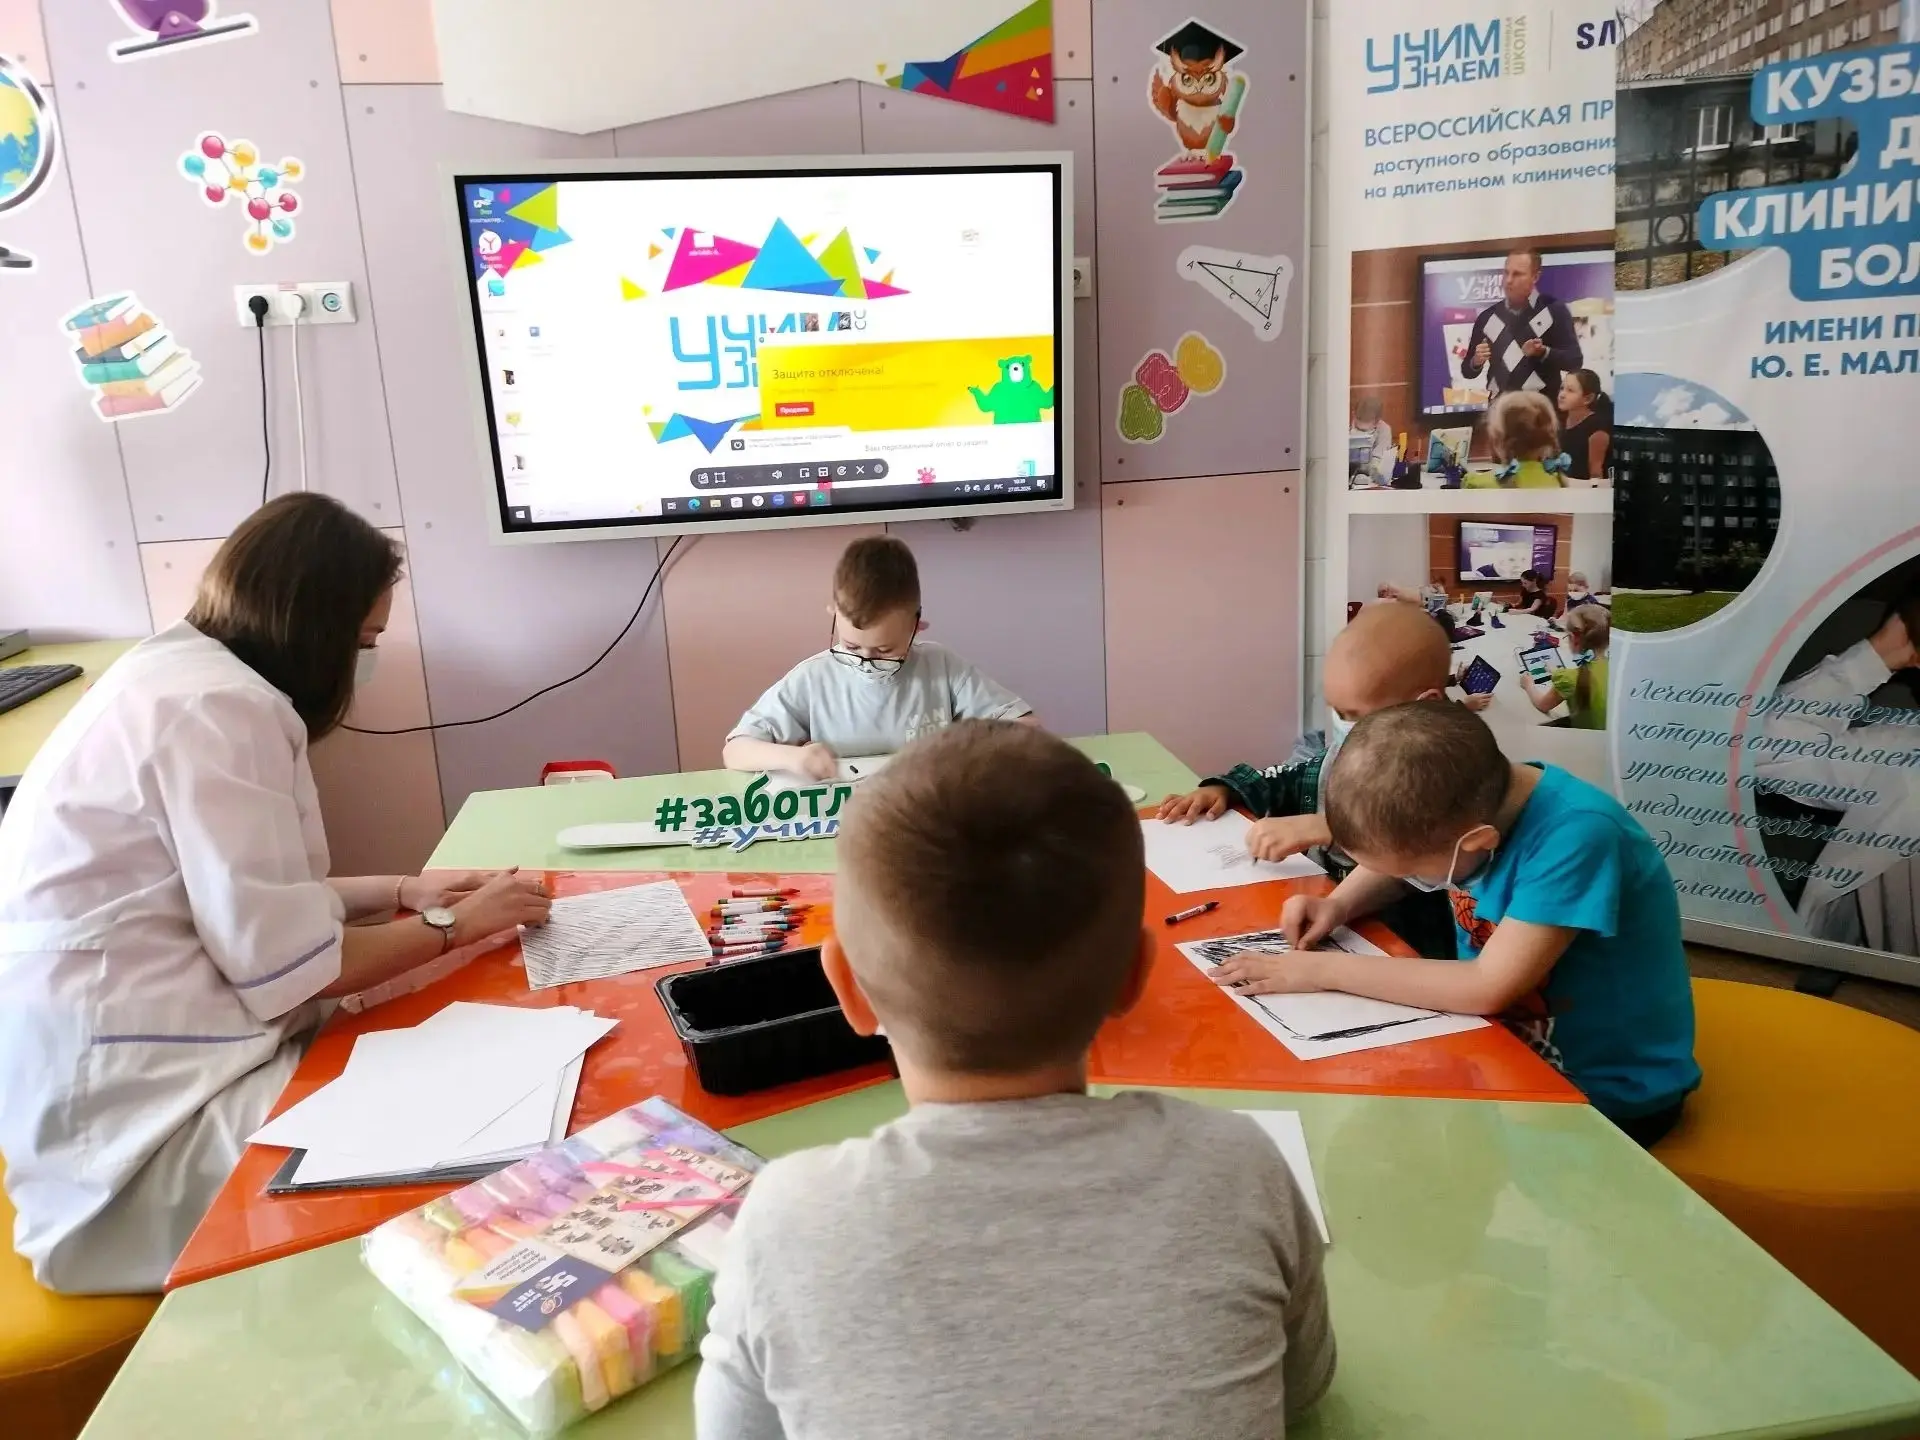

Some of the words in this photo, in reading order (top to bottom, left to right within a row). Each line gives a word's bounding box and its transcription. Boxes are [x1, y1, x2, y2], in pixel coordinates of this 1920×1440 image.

[1767, 51, 1920, 114] КУЗБ
[1365, 107, 1571, 147] ВСЕРОССИЙСКАЯ
[1374, 152, 1480, 175] доступного
[1364, 185, 1386, 199] на
[1392, 174, 1505, 198] длительном
[1714, 178, 1920, 239] КЛИНИ
[1765, 315, 1883, 344] ИМЕНИ
[772, 369, 815, 380] Защита
[819, 366, 885, 378] отключена!
[1751, 355, 1793, 378] Ю.
[1804, 354, 1829, 376] Е.
[1841, 350, 1919, 375] МАЛ
[1630, 678, 1752, 709] Лечебное
[1628, 720, 1743, 751] которое
[1621, 760, 1728, 787] уровень
[1735, 773, 1878, 806] оказания
[1627, 793, 1814, 838] медицинской
[1653, 831, 1863, 889] дростающему
